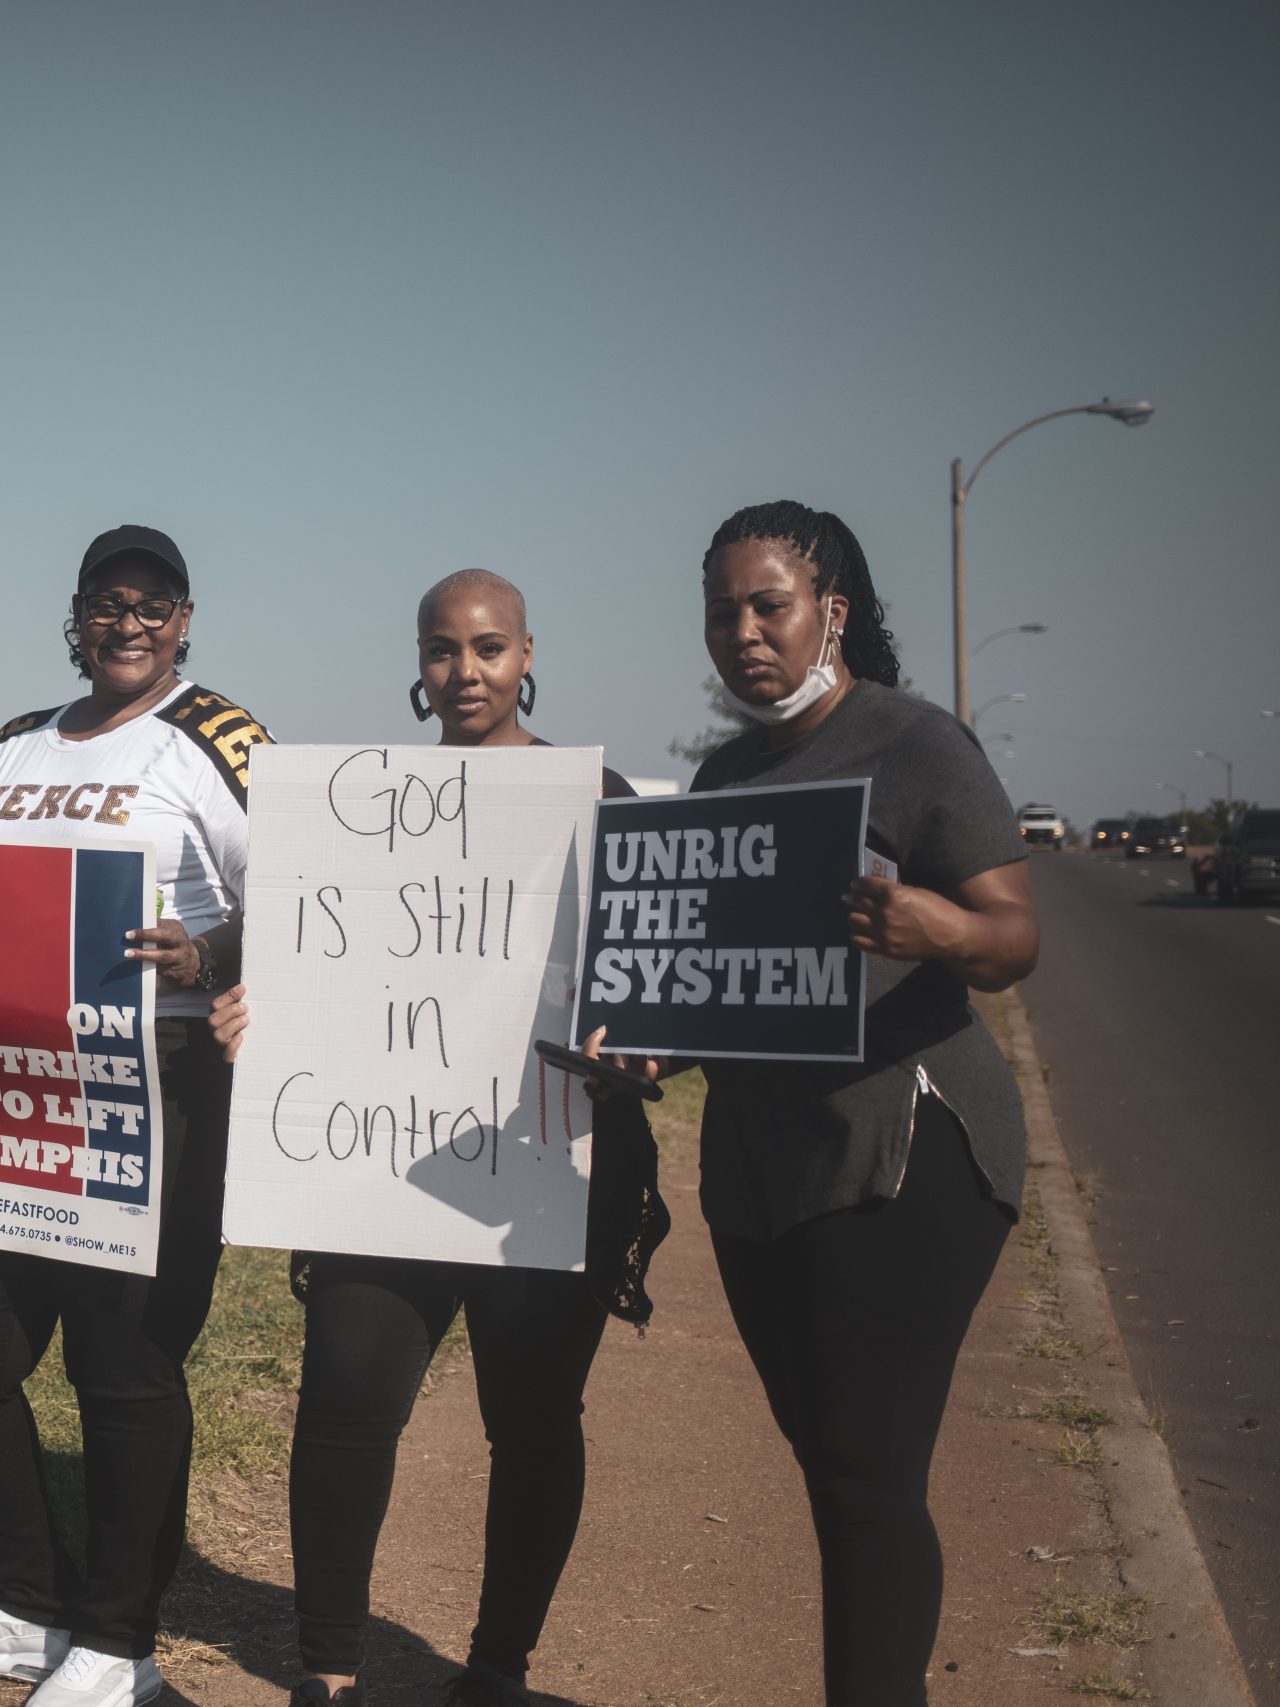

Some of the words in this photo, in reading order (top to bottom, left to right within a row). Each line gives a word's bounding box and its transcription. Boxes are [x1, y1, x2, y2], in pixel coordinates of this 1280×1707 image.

[329, 748, 467, 859] God
[604, 824, 778, 882] UNRIG
[599, 888, 708, 940] THE
[590, 946, 848, 1006] SYSTEM
[66, 1003, 136, 1039] ON
[385, 985, 449, 1068] in
[44, 1093, 145, 1136] LIFT
[65, 1235, 137, 1257] @SHOW_ME15
